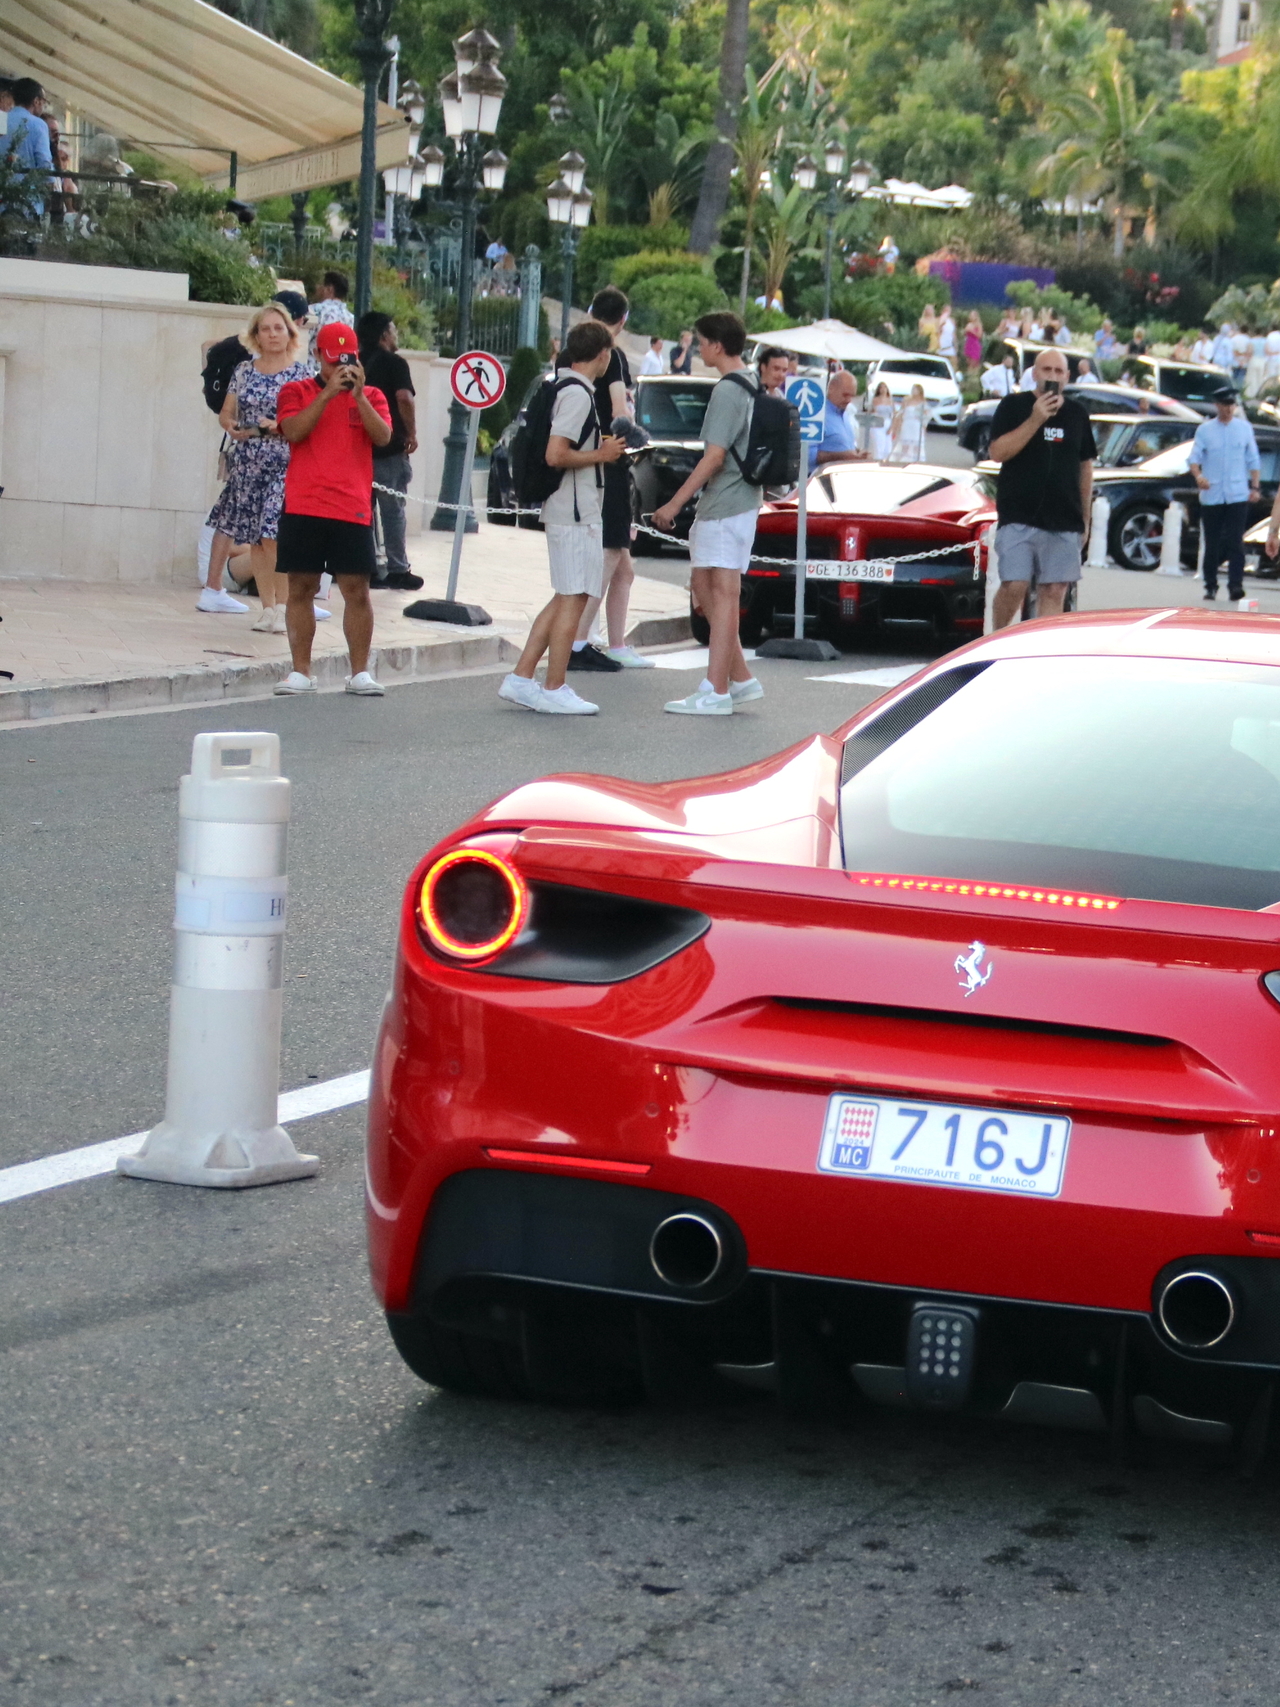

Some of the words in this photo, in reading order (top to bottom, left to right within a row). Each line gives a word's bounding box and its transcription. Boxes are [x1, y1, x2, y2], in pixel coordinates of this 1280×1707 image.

[843, 1137, 864, 1146] 2024
[890, 1107, 1052, 1175] 716J
[839, 1146, 863, 1165] MC
[894, 1165, 960, 1180] PRINCIPAUTE
[969, 1173, 982, 1182] DE
[990, 1176, 1036, 1188] MONACO
